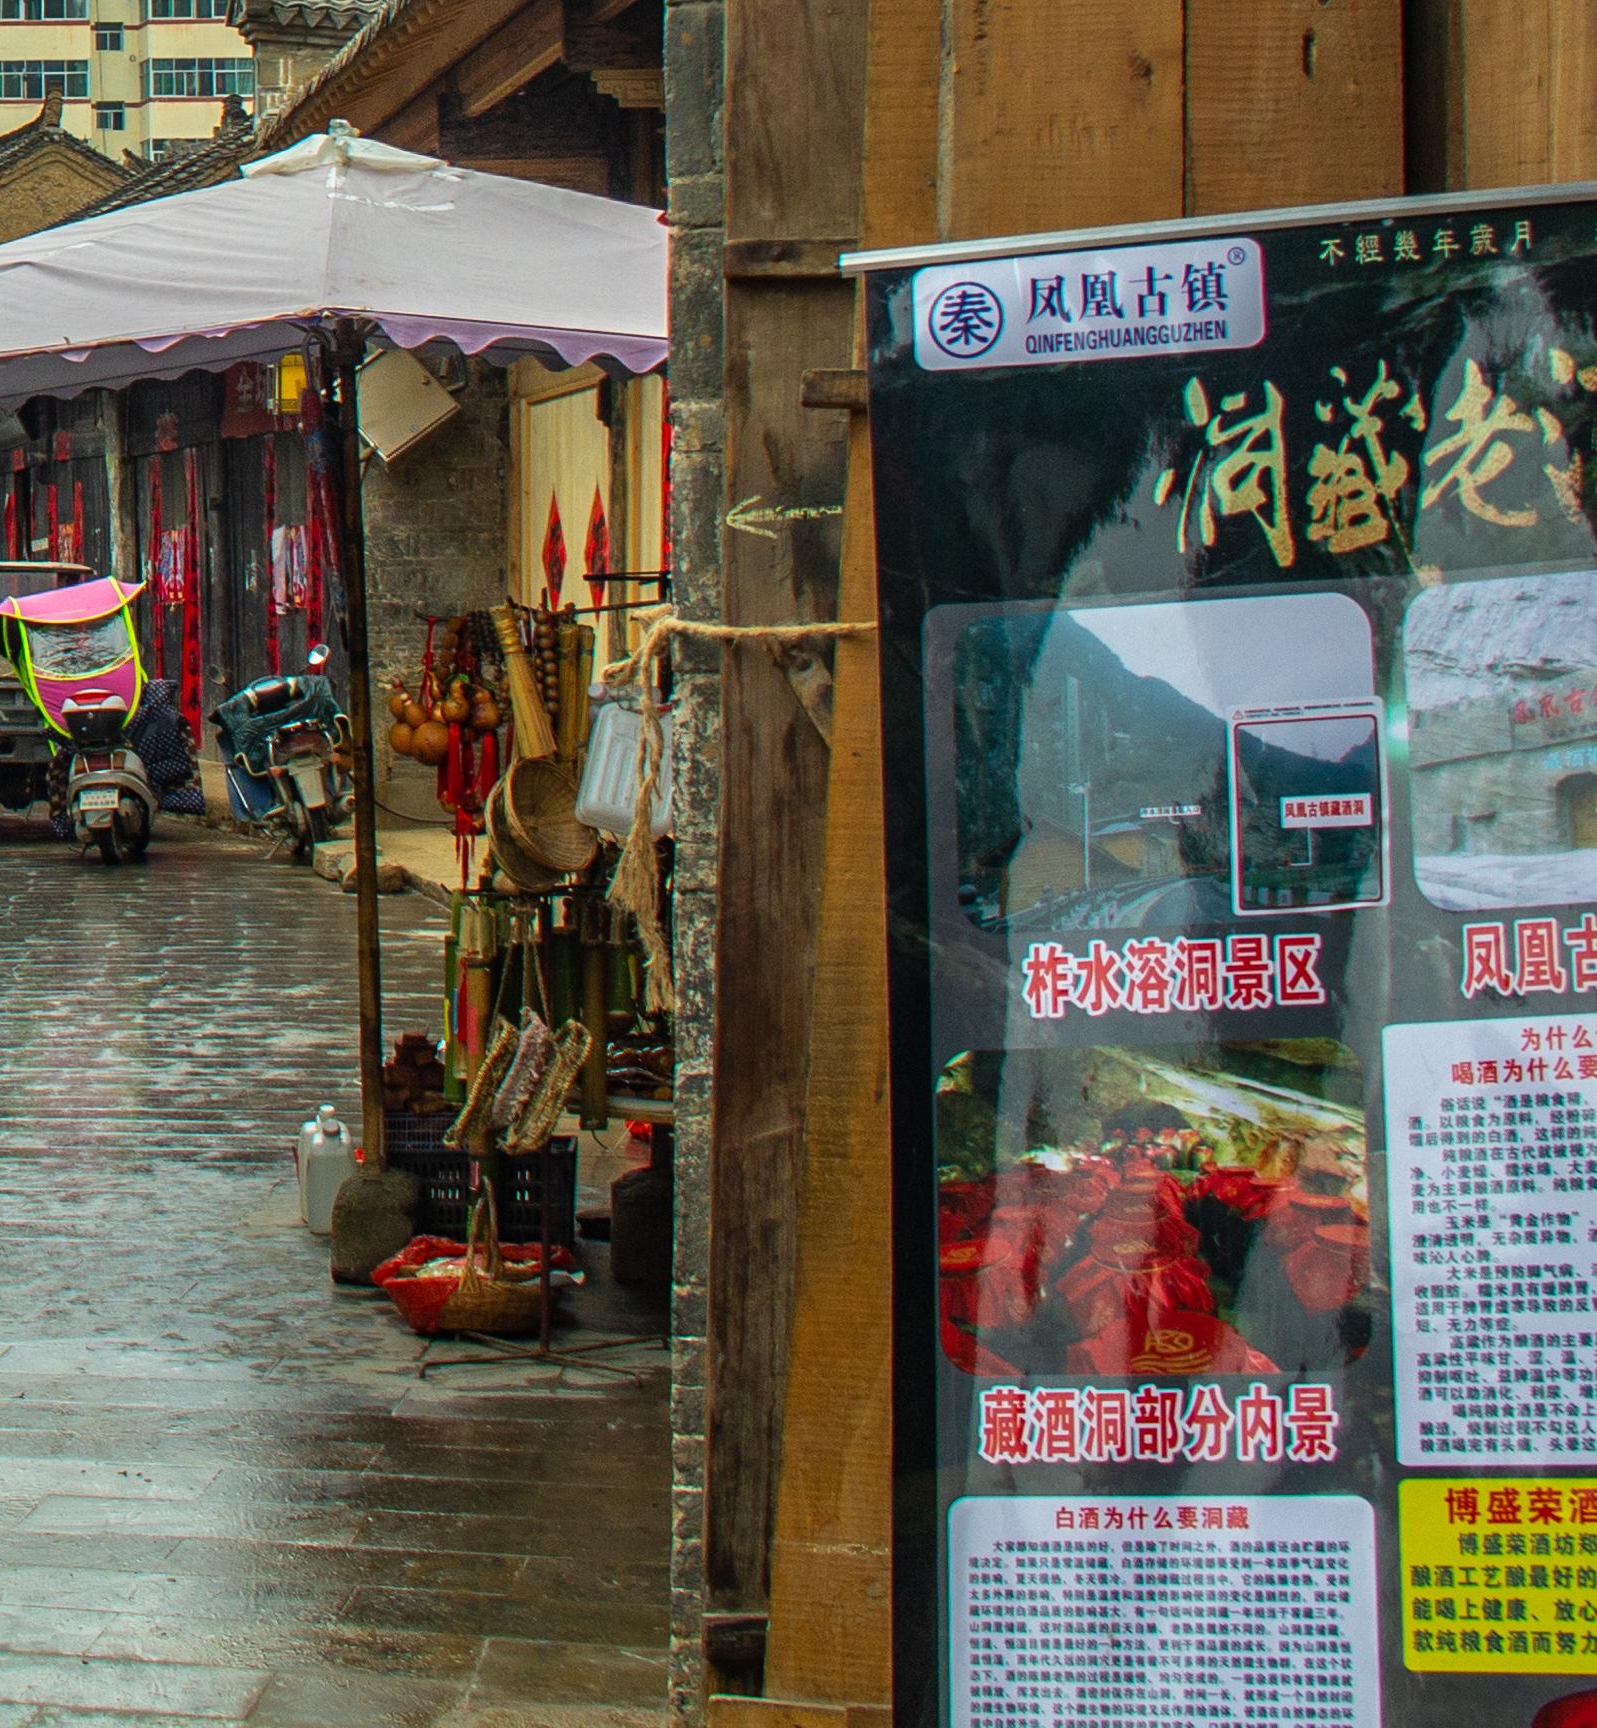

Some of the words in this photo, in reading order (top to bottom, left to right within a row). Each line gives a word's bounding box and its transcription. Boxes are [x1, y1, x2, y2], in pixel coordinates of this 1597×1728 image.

[1320, 220, 1534, 268] 不經幾年歲月
[1024, 259, 1230, 324] 凤凰古镇
[1024, 318, 1228, 356] QINFENGHUANGGUZHEN
[1153, 346, 1597, 586] 洞藏老
[1284, 799, 1365, 818] 凤凰古镇藏酒洞
[1022, 935, 1326, 1018] 柞水溶洞景区
[1520, 1024, 1597, 1052] 为什么
[1451, 1054, 1597, 1085] 喝酒为什么要
[977, 1384, 1337, 1465] 藏酒洞部分内景
[1055, 1505, 1250, 1530] 白酒为什么要洞藏
[1445, 1486, 1597, 1525] 博盛荣酒
[1410, 1564, 1597, 1589] 酿酒工艺酿最好的
[1411, 1596, 1597, 1622] 能喝上健康、放心
